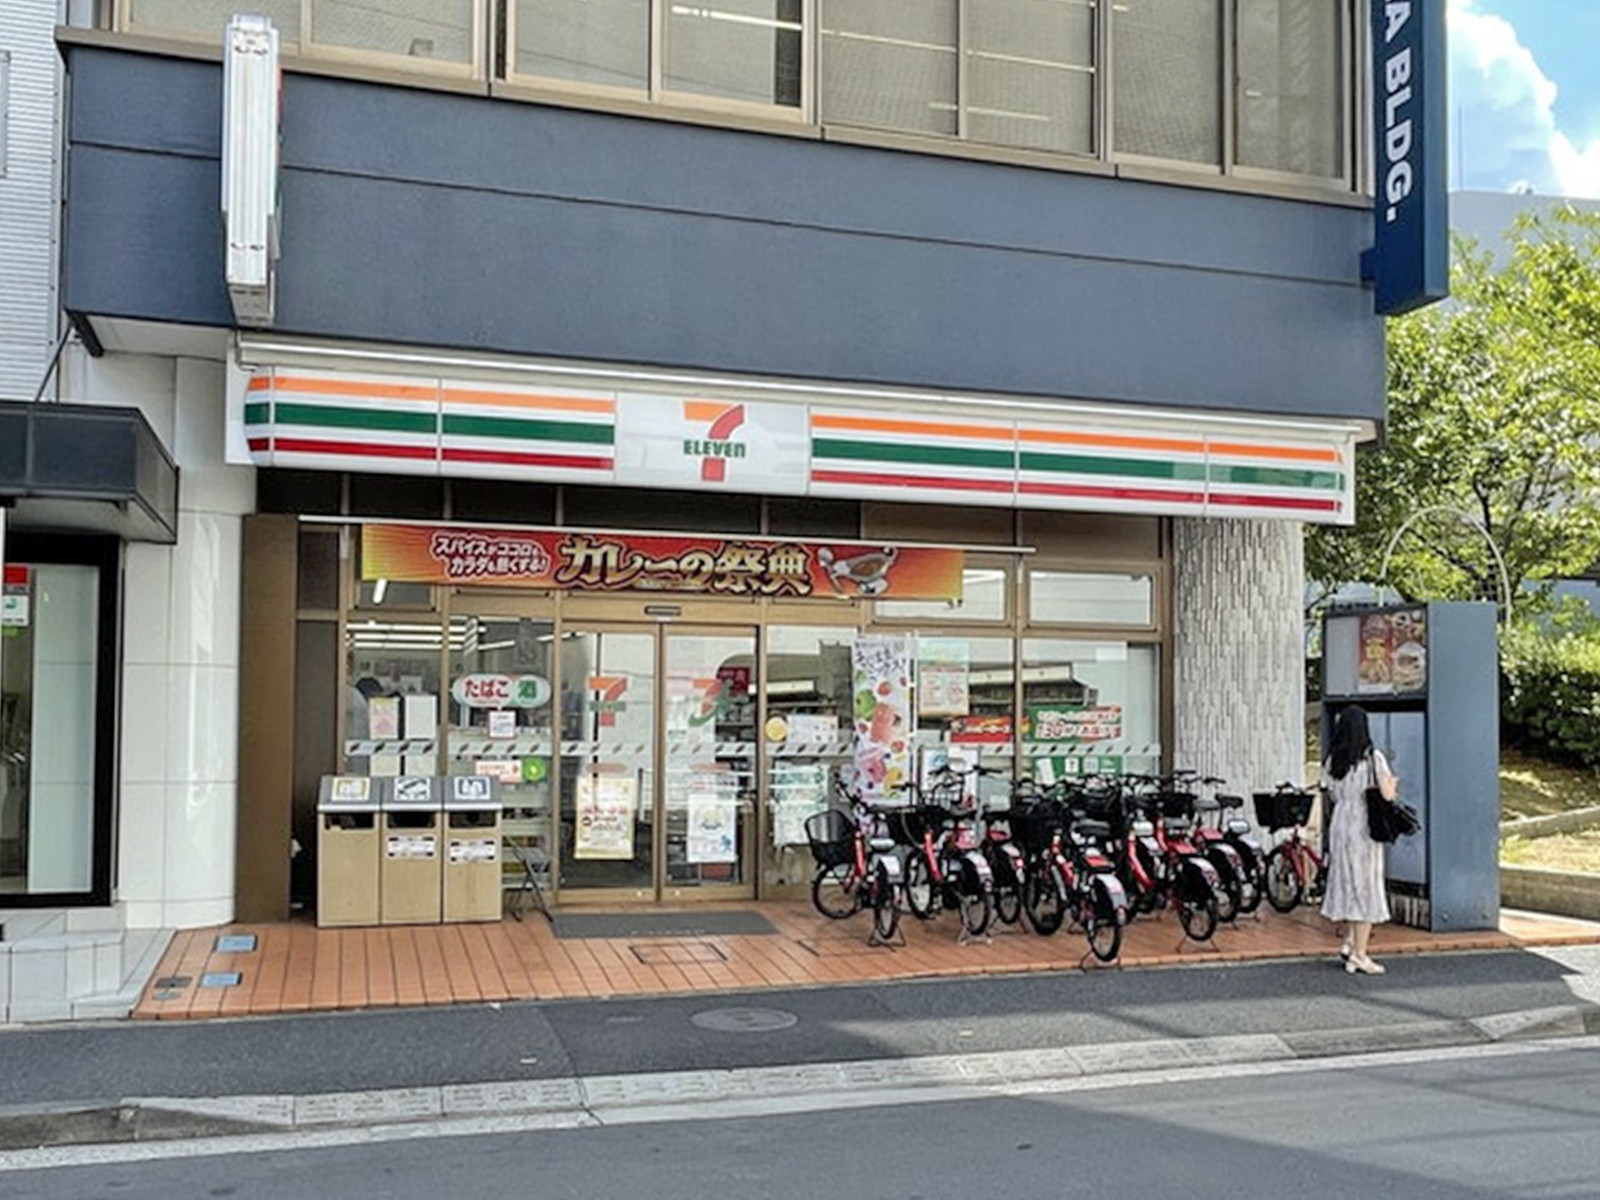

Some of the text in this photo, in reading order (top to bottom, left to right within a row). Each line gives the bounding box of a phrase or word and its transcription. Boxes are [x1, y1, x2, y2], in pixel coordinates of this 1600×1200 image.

[1385, 0, 1413, 223] A BLDG.
[683, 401, 745, 482] 7
[555, 537, 813, 597] カレーの祭典
[465, 679, 510, 698] たばこ
